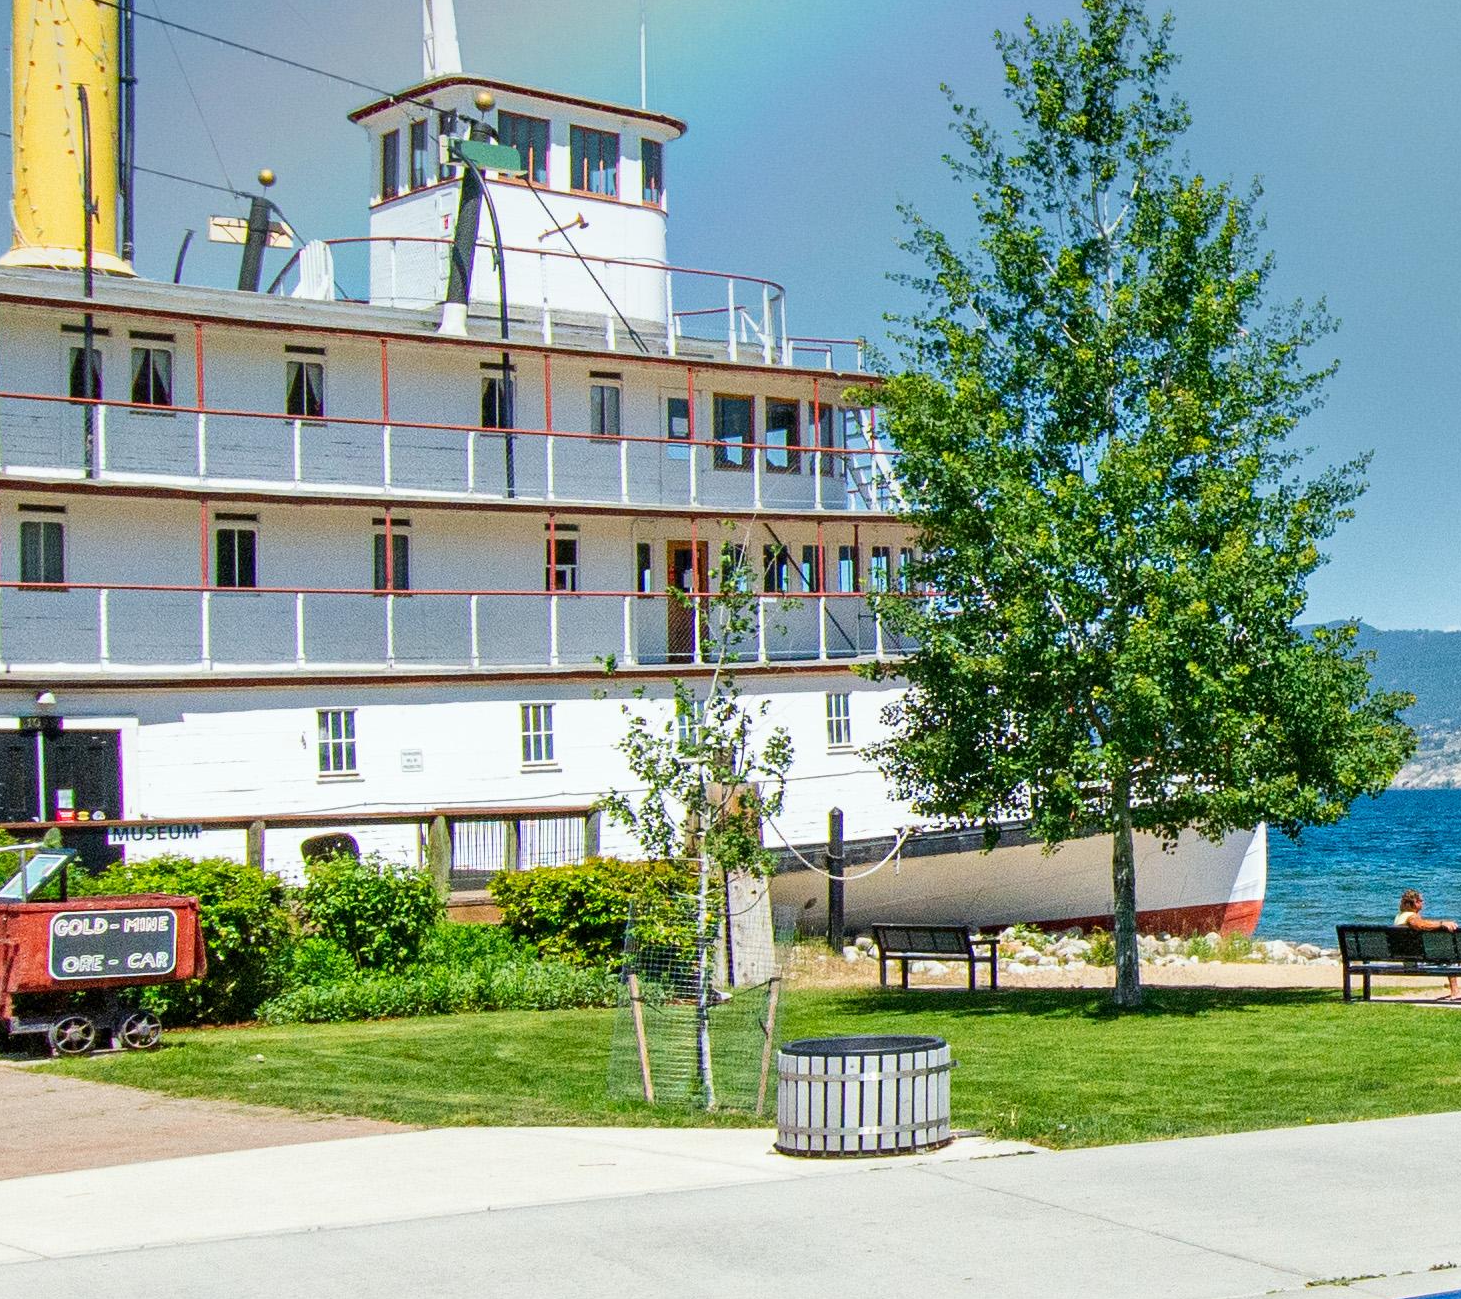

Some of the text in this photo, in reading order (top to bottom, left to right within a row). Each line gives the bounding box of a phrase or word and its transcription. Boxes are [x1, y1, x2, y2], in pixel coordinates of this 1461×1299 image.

[113, 824, 200, 843] MUSEUM
[54, 917, 108, 937] GOLD
[123, 915, 169, 933] MINE
[62, 954, 105, 972] ORE
[127, 951, 168, 969] CAR
